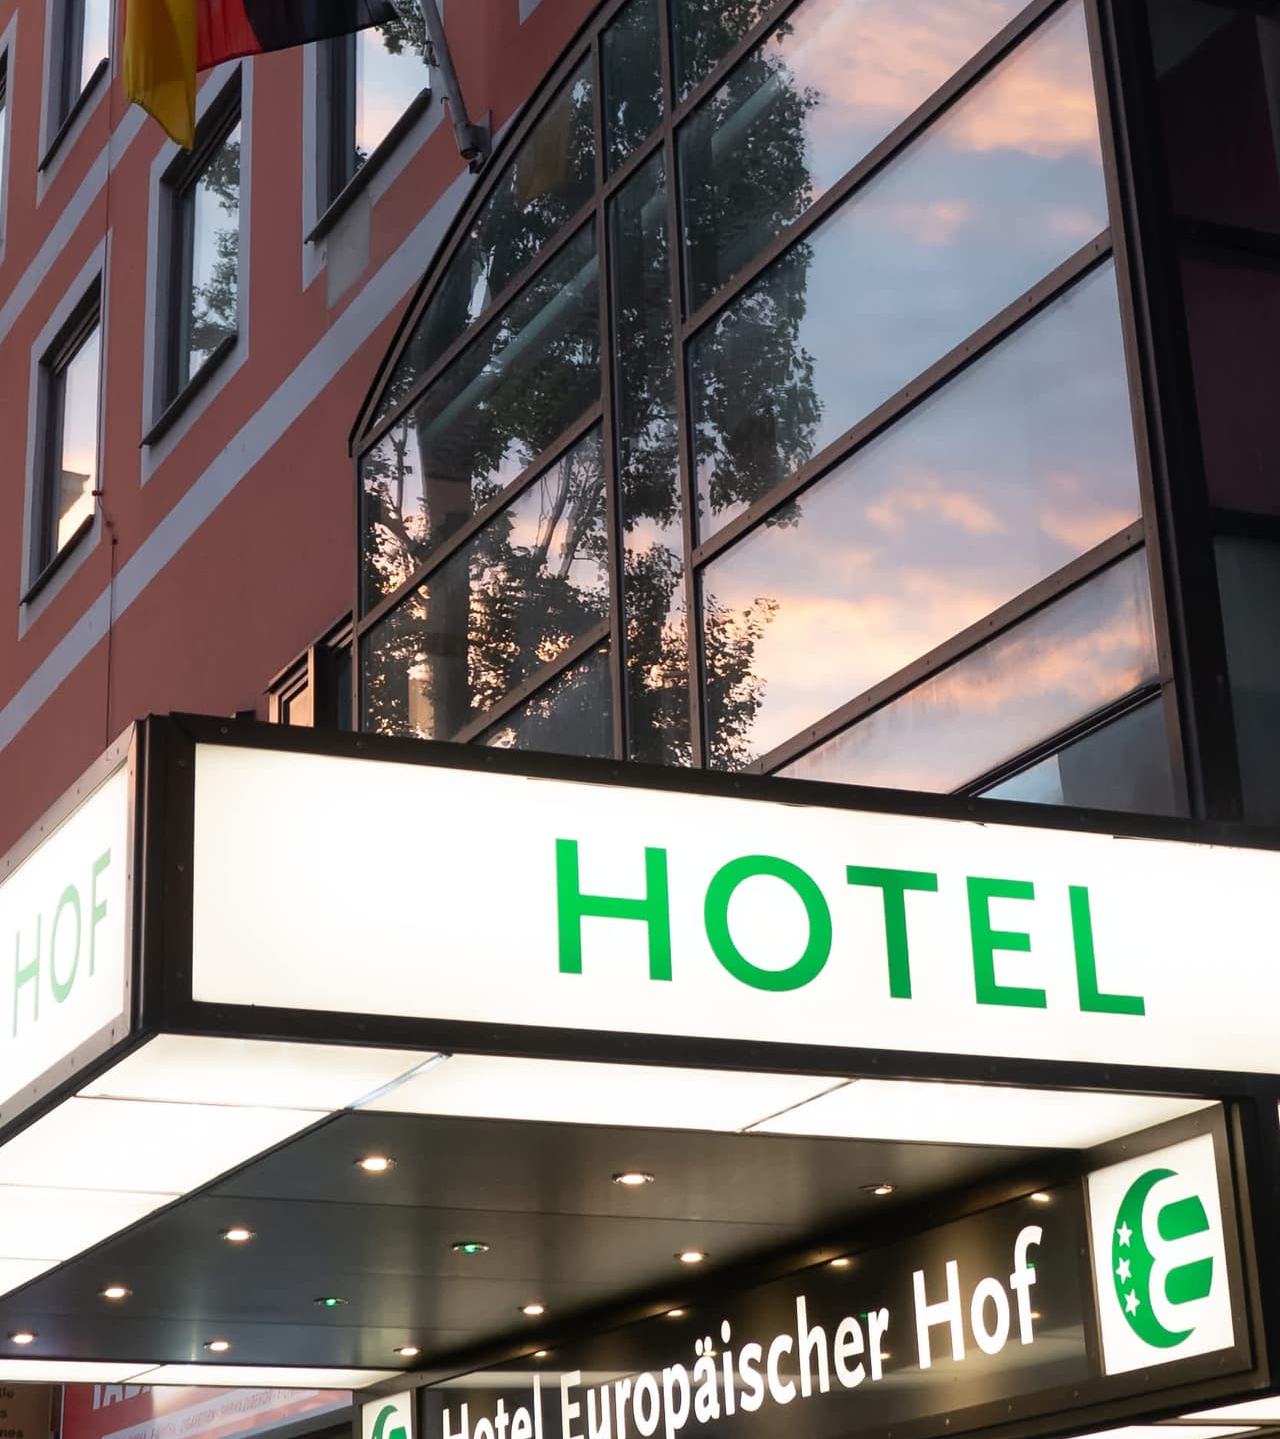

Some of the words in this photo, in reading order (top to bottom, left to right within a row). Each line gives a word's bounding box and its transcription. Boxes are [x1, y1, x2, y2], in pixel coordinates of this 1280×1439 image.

[12, 847, 112, 1040] HOF
[555, 838, 1146, 1016] HOTEL
[912, 1225, 1043, 1370] Hof
